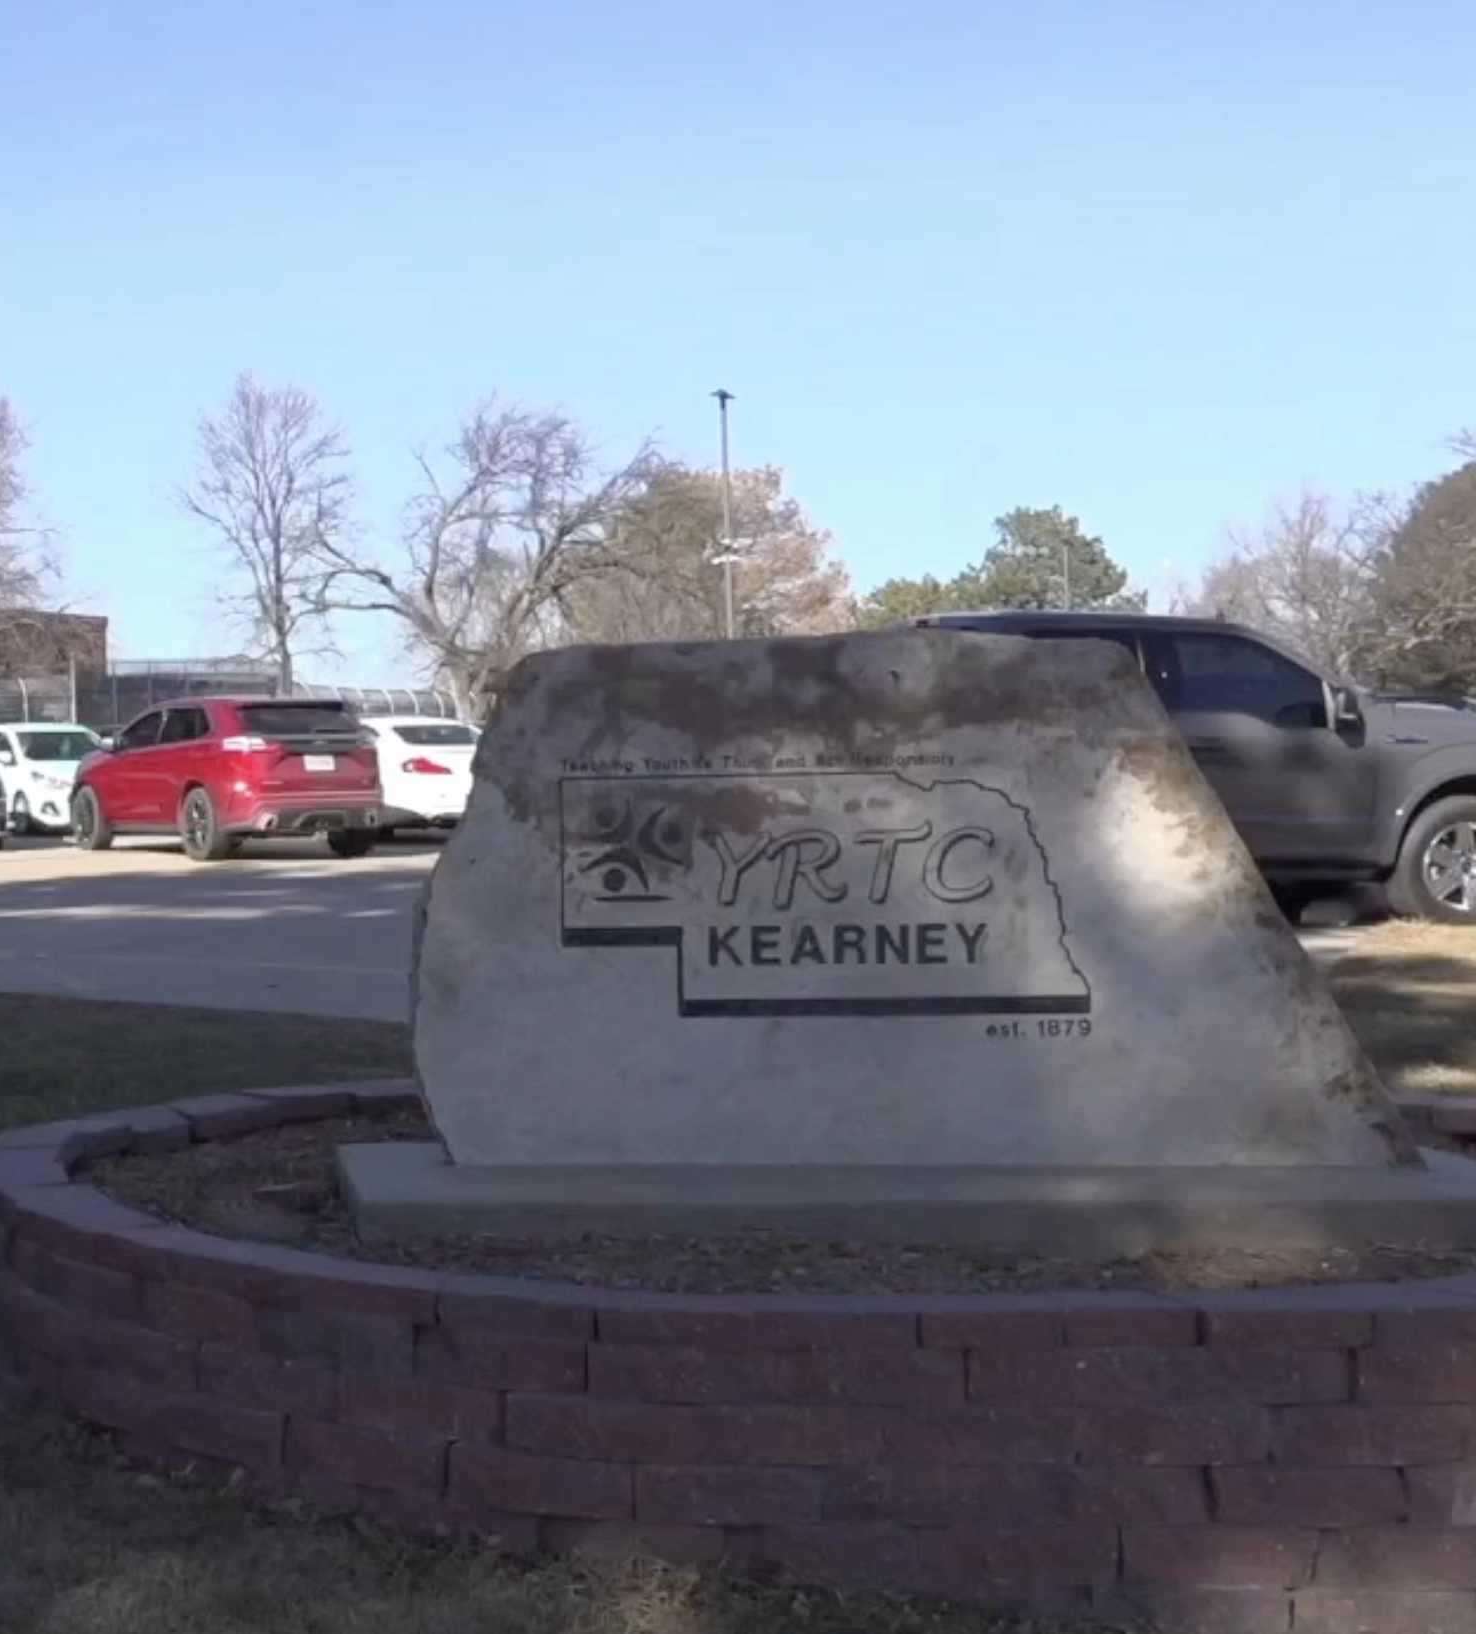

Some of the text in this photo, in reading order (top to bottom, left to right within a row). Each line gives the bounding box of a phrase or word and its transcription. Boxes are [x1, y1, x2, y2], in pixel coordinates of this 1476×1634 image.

[643, 757, 689, 771] Youth
[776, 756, 805, 768] and
[705, 820, 995, 909] YRTC
[708, 923, 988, 966] KEARNEY
[986, 1018, 1092, 1038] est. 1879
